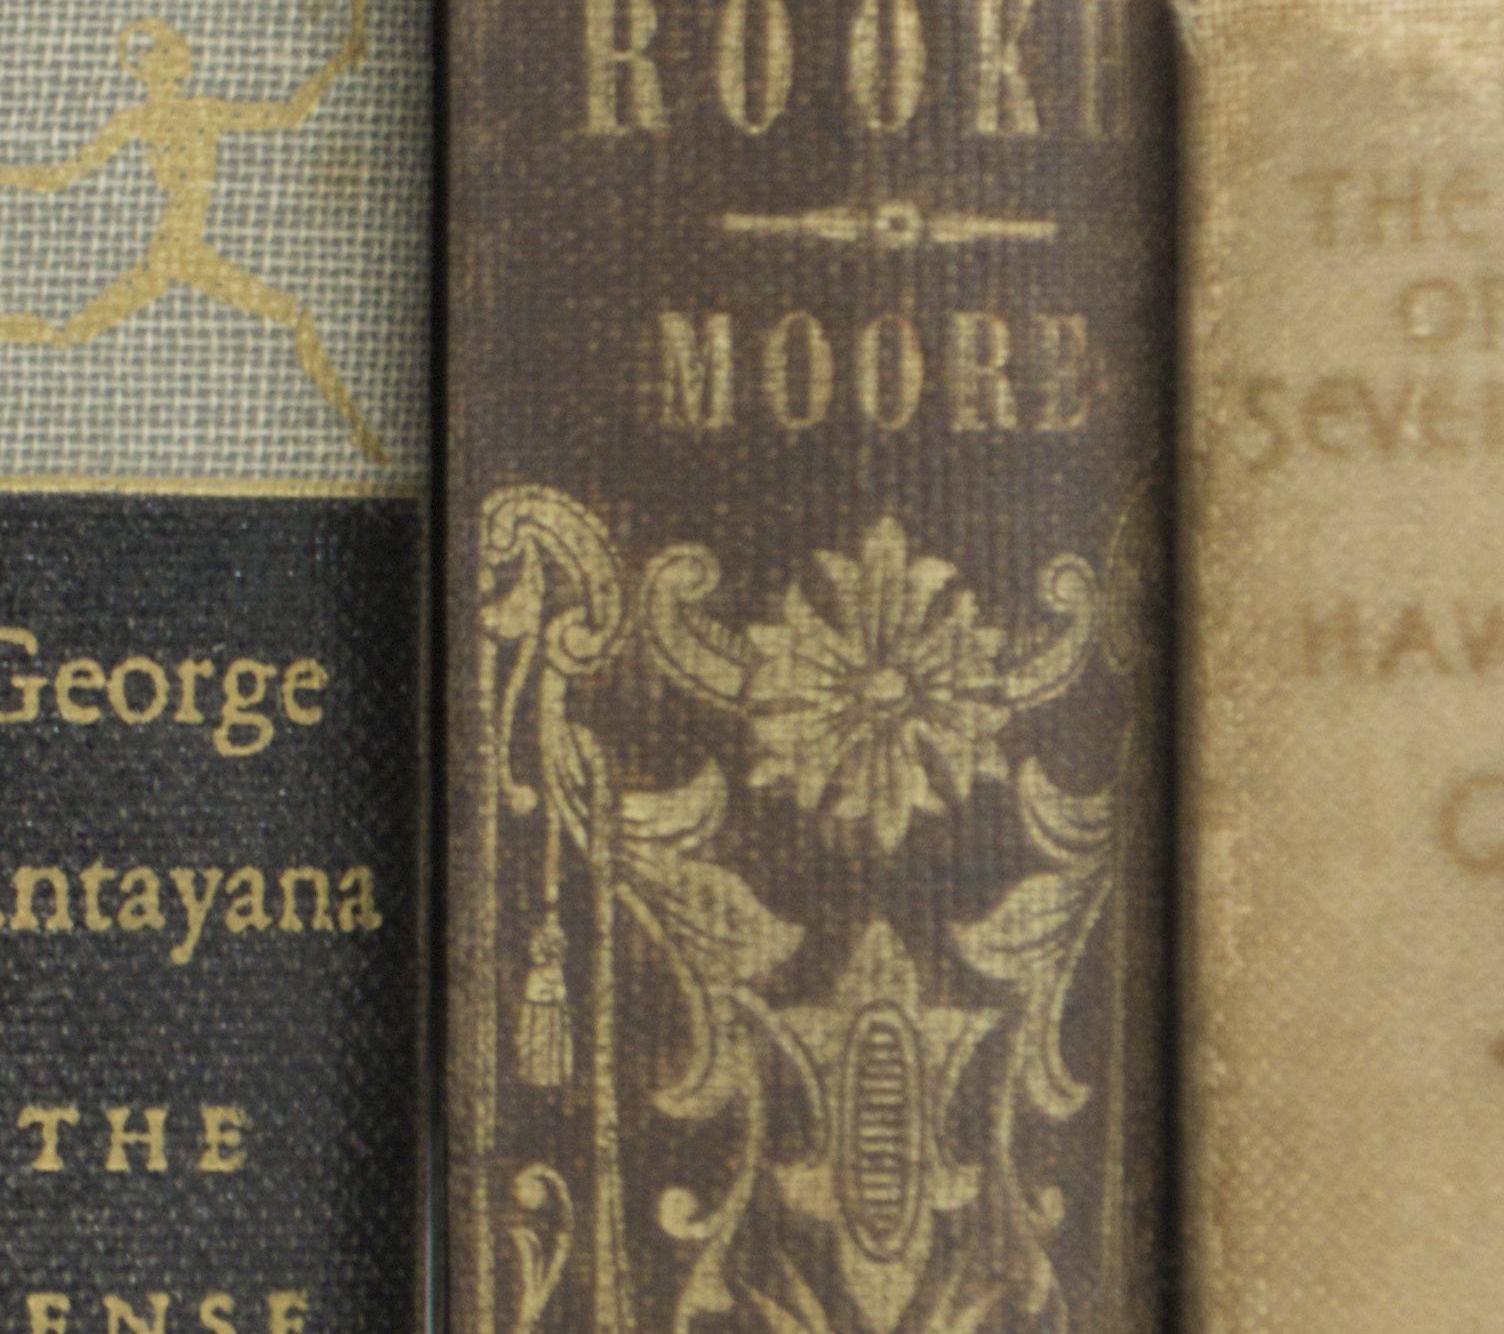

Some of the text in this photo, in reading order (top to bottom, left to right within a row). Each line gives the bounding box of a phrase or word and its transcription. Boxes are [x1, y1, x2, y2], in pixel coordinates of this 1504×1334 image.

[1294, 165, 1494, 249] THE
[657, 310, 1092, 434] MOORE
[18, 1105, 245, 1172] THE
